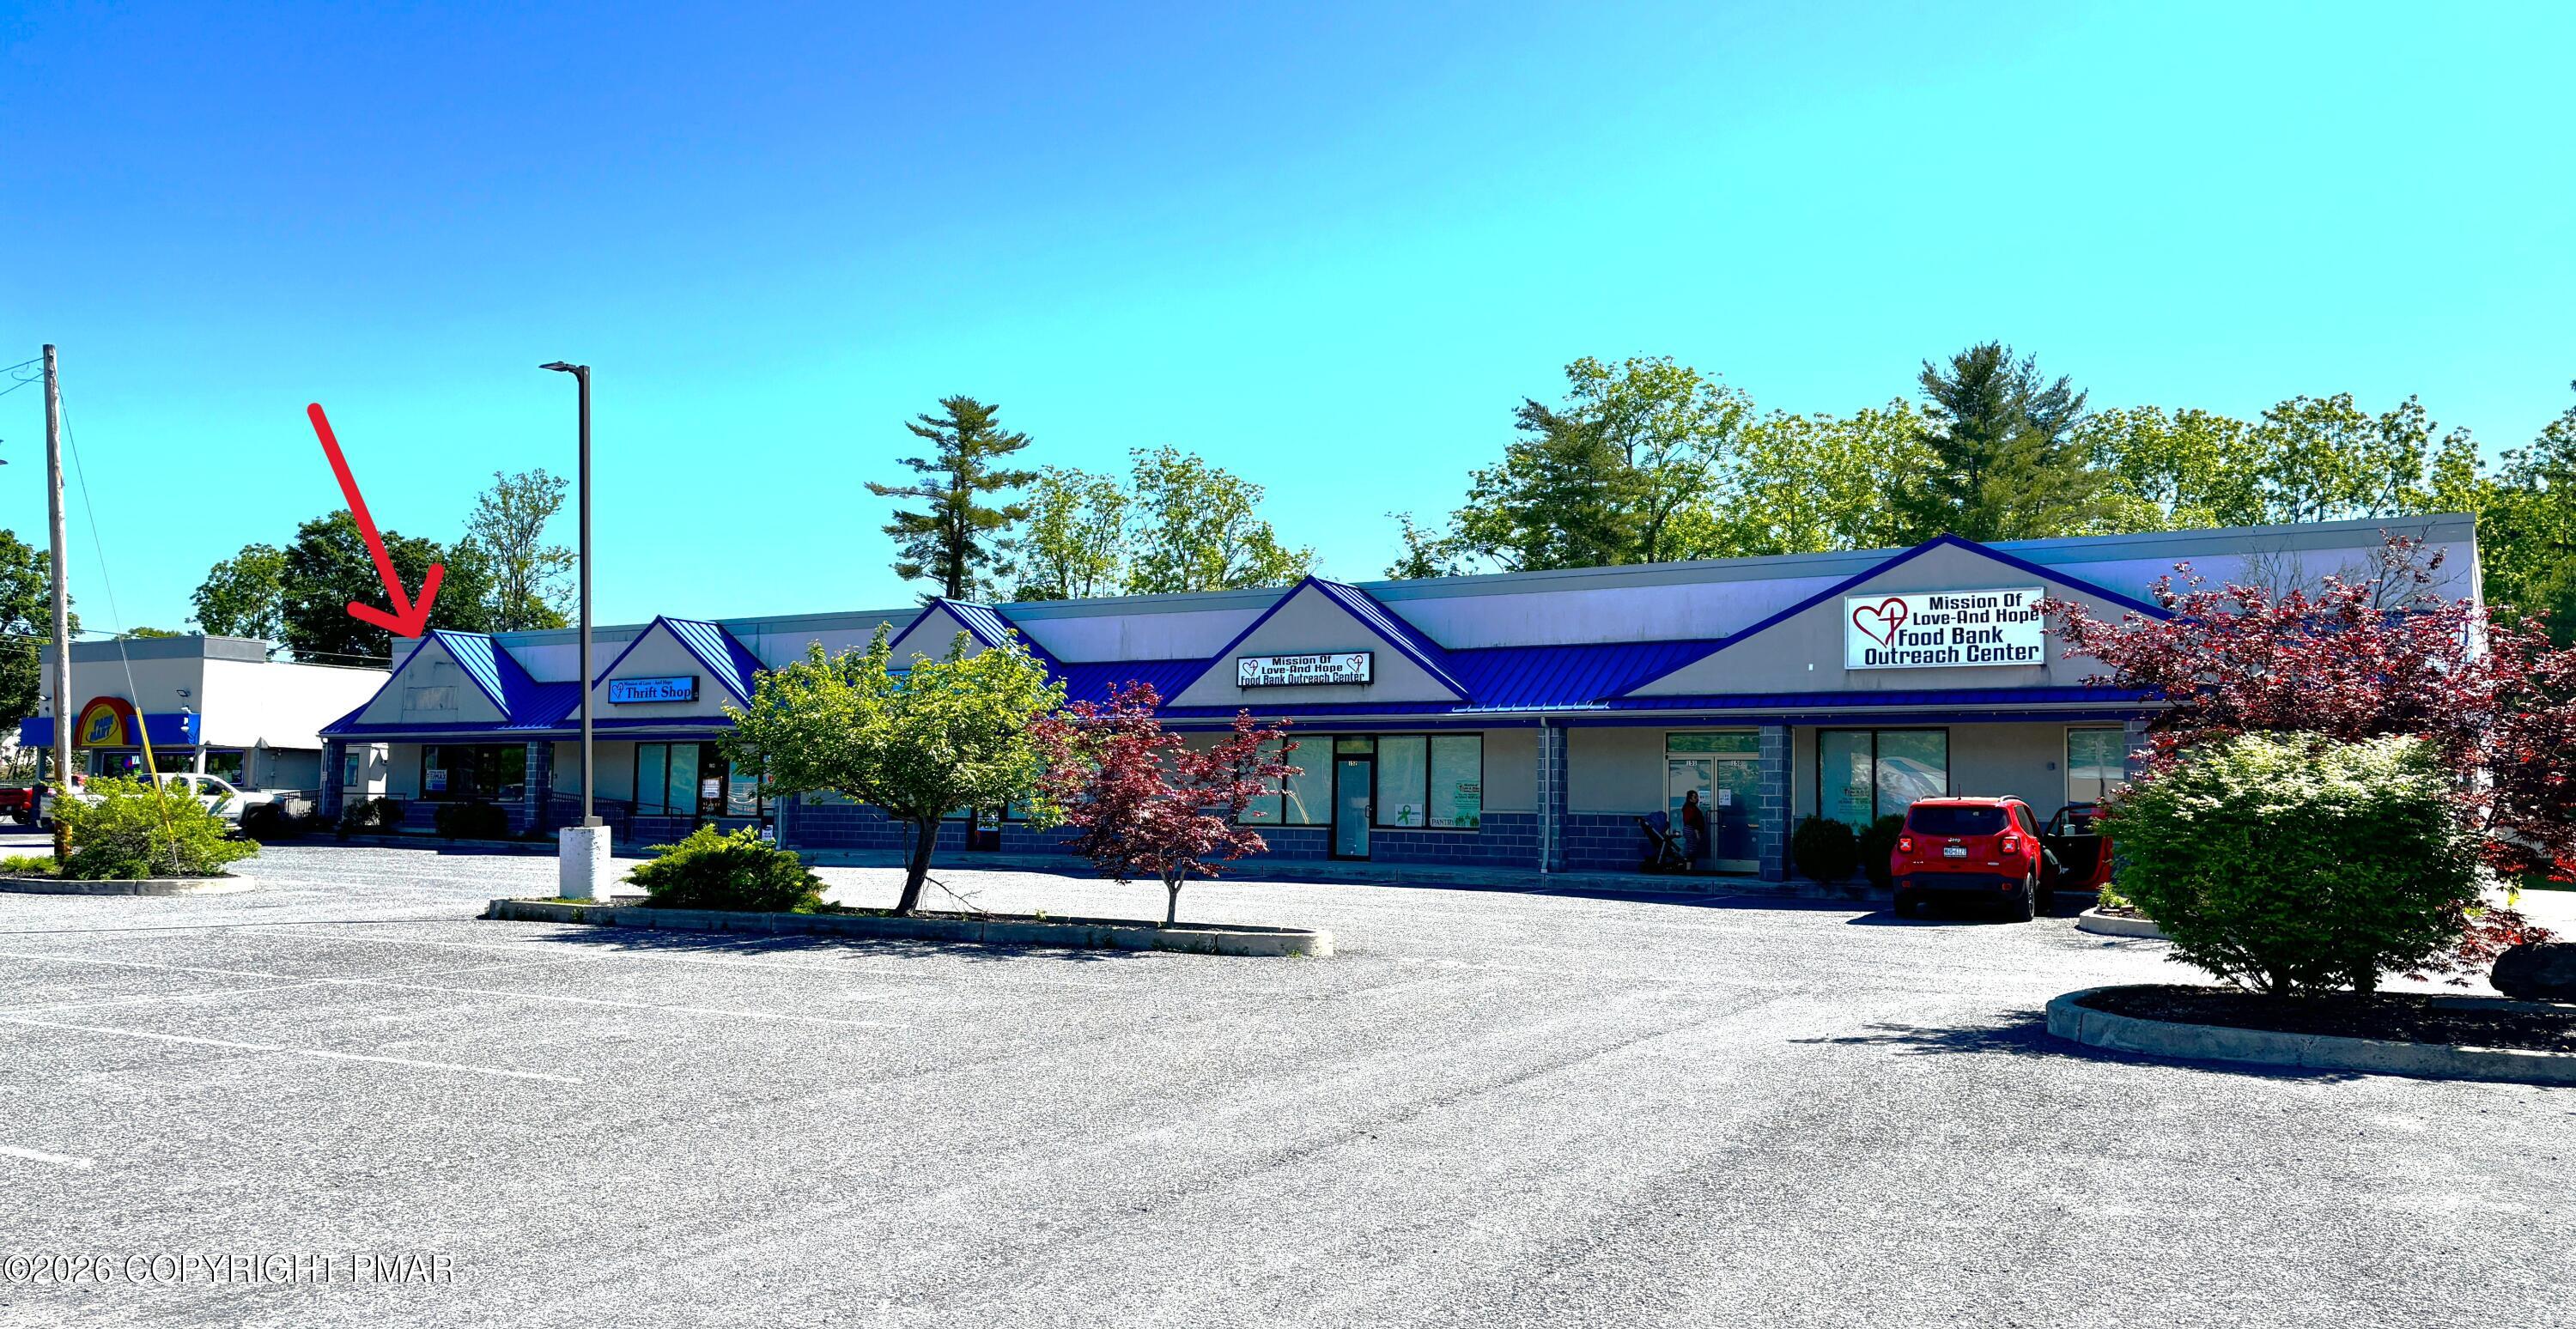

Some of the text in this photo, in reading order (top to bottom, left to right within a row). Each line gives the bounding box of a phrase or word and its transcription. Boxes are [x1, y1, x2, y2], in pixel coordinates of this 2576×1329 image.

[1929, 593, 2022, 610] Mission Of
[1913, 608, 2039, 626] Love-And Hope
[1899, 626, 2003, 646] Food Bank
[1272, 655, 1332, 666] Mission Of
[1865, 643, 2039, 665] Outreach Center
[1261, 664, 1343, 675] Love-And Hope
[1288, 671, 1365, 684] Outreach Center
[1241, 674, 1285, 686] Food Bank
[625, 685, 691, 701] Thrift Shop
